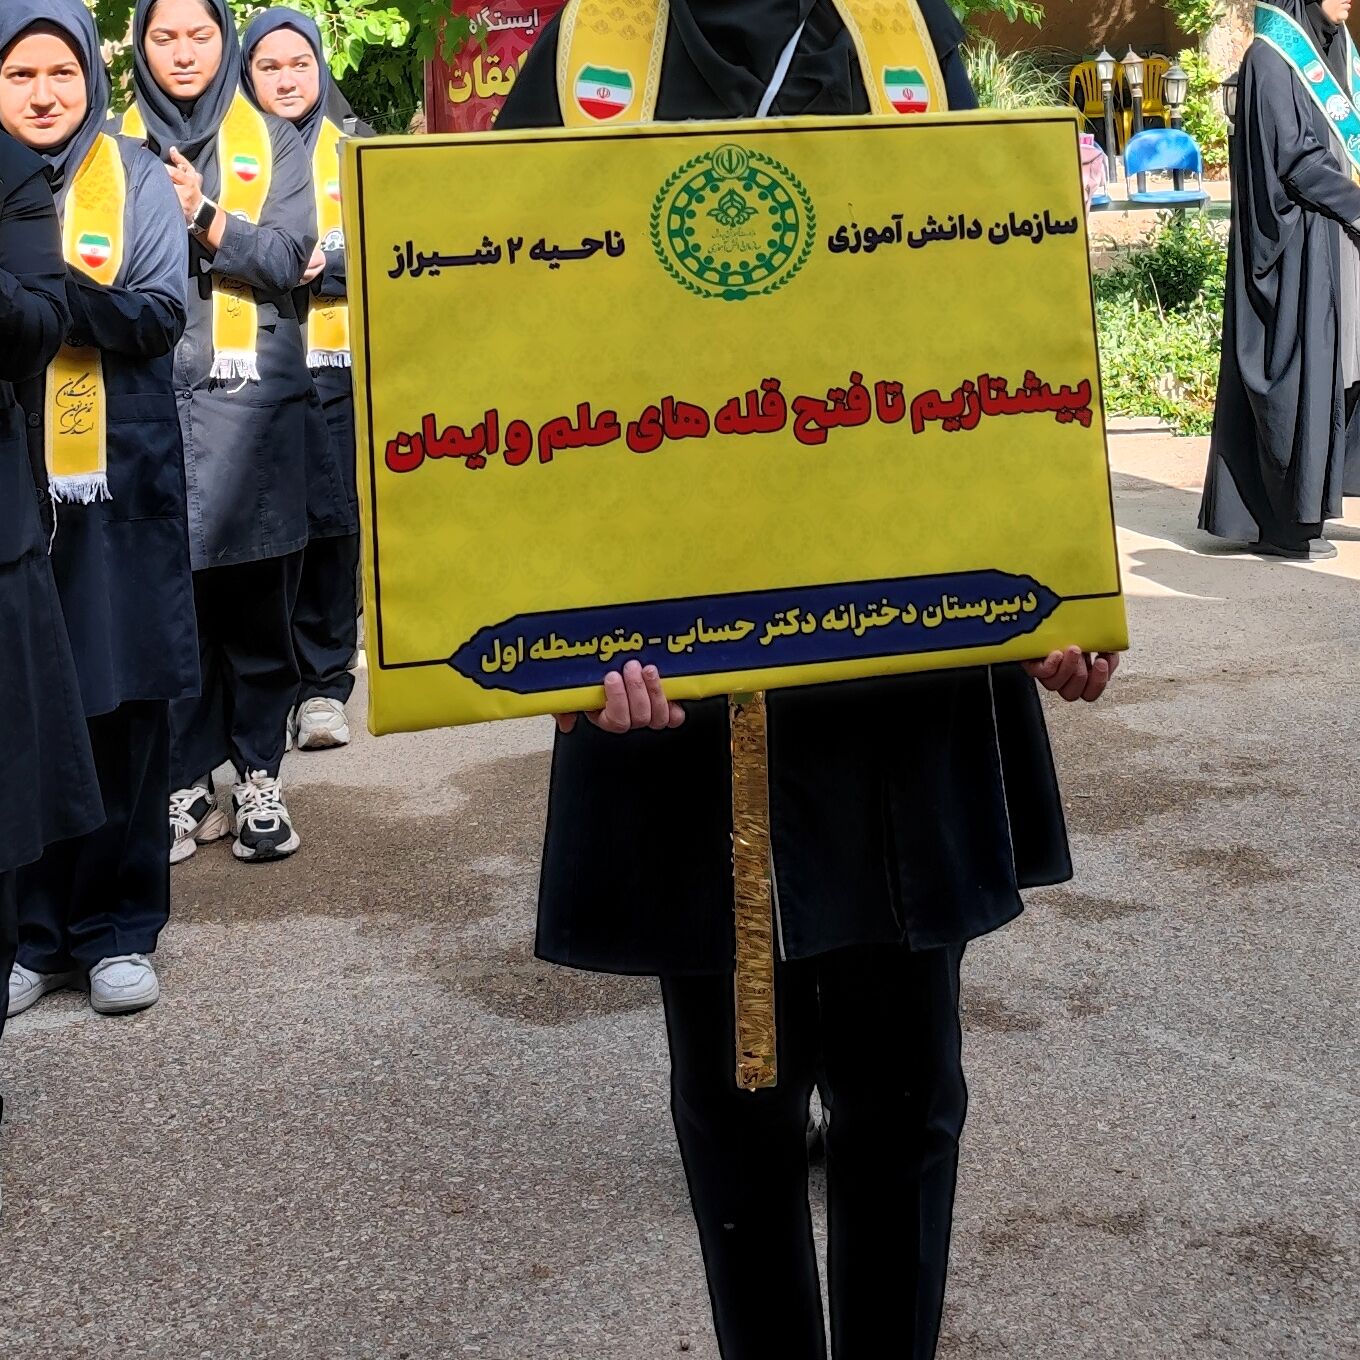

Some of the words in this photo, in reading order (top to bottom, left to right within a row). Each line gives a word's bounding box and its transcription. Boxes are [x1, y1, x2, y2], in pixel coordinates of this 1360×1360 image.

[469, 6, 540, 35] ایستگاه
[827, 213, 904, 255] آموزی
[907, 214, 983, 249] دانش
[988, 210, 1079, 245] سازمان
[388, 235, 502, 279] شیراز
[529, 230, 626, 271] ناحیه
[713, 377, 787, 435] قله
[791, 371, 871, 445] فتح
[874, 379, 907, 423] تا
[910, 370, 1092, 435] پیشتازیم
[385, 408, 499, 473] ایمان
[503, 419, 533, 466] و
[538, 401, 622, 464] علم
[625, 395, 710, 454] های
[758, 607, 817, 646] دکتر
[821, 597, 918, 638] دخترانه
[921, 591, 1038, 628] دبیرستان
[480, 636, 524, 673] اول
[528, 628, 644, 663] متوسطه
[666, 616, 756, 654] حسابی
